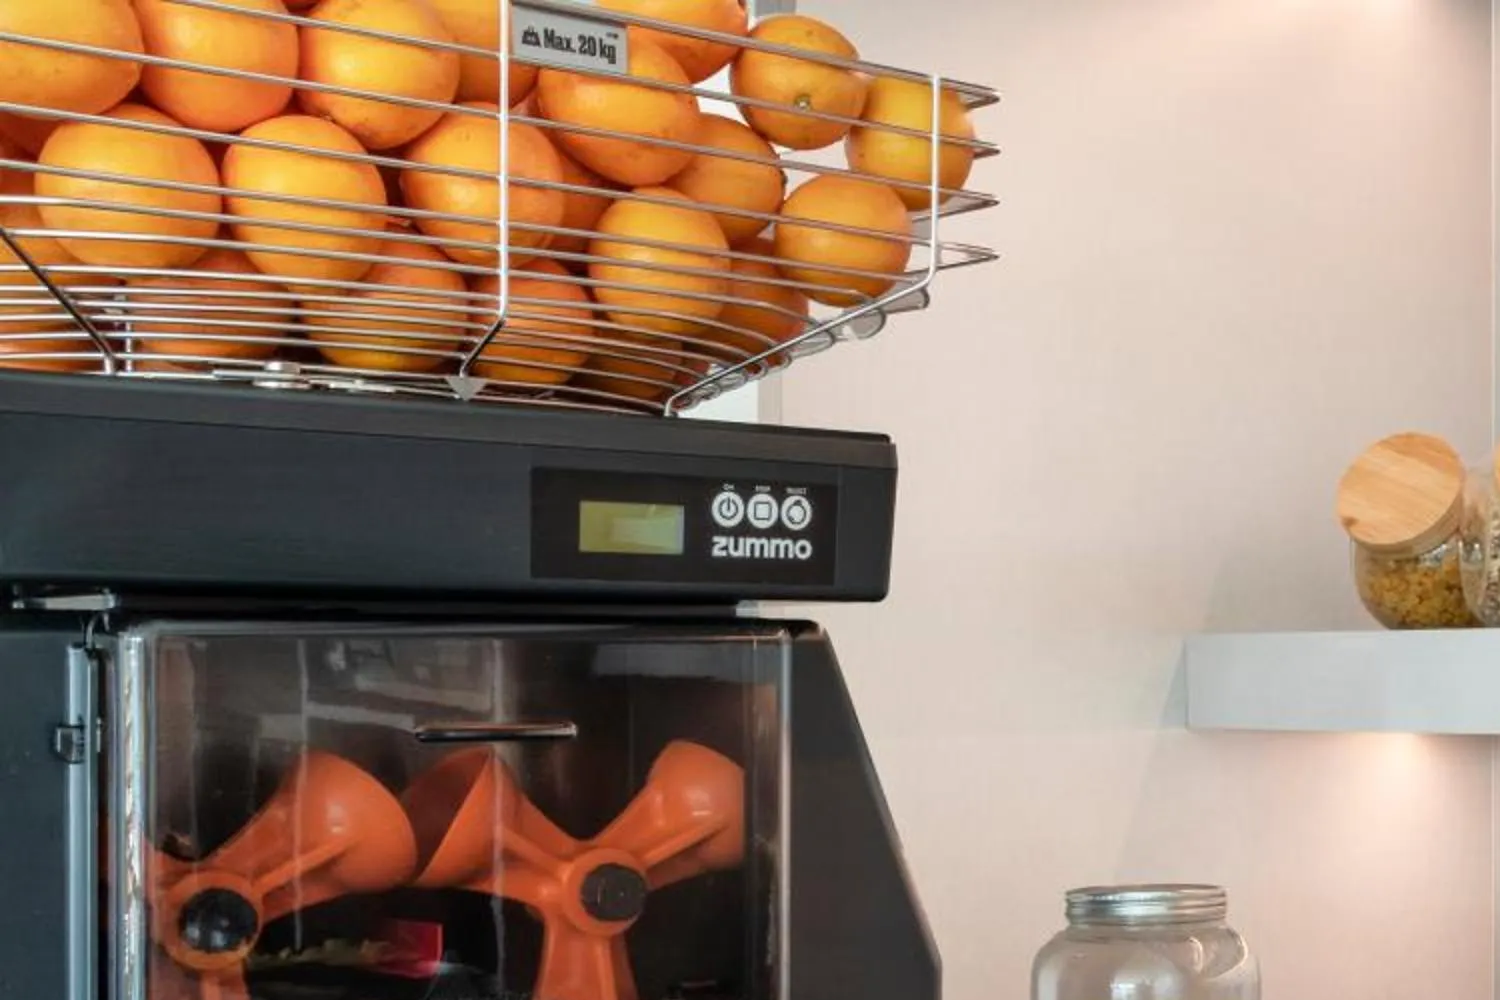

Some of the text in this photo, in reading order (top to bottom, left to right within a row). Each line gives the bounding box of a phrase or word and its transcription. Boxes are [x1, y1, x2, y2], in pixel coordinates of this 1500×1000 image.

[543, 27, 617, 65] Max. 20 kg
[712, 535, 812, 560] zummo
